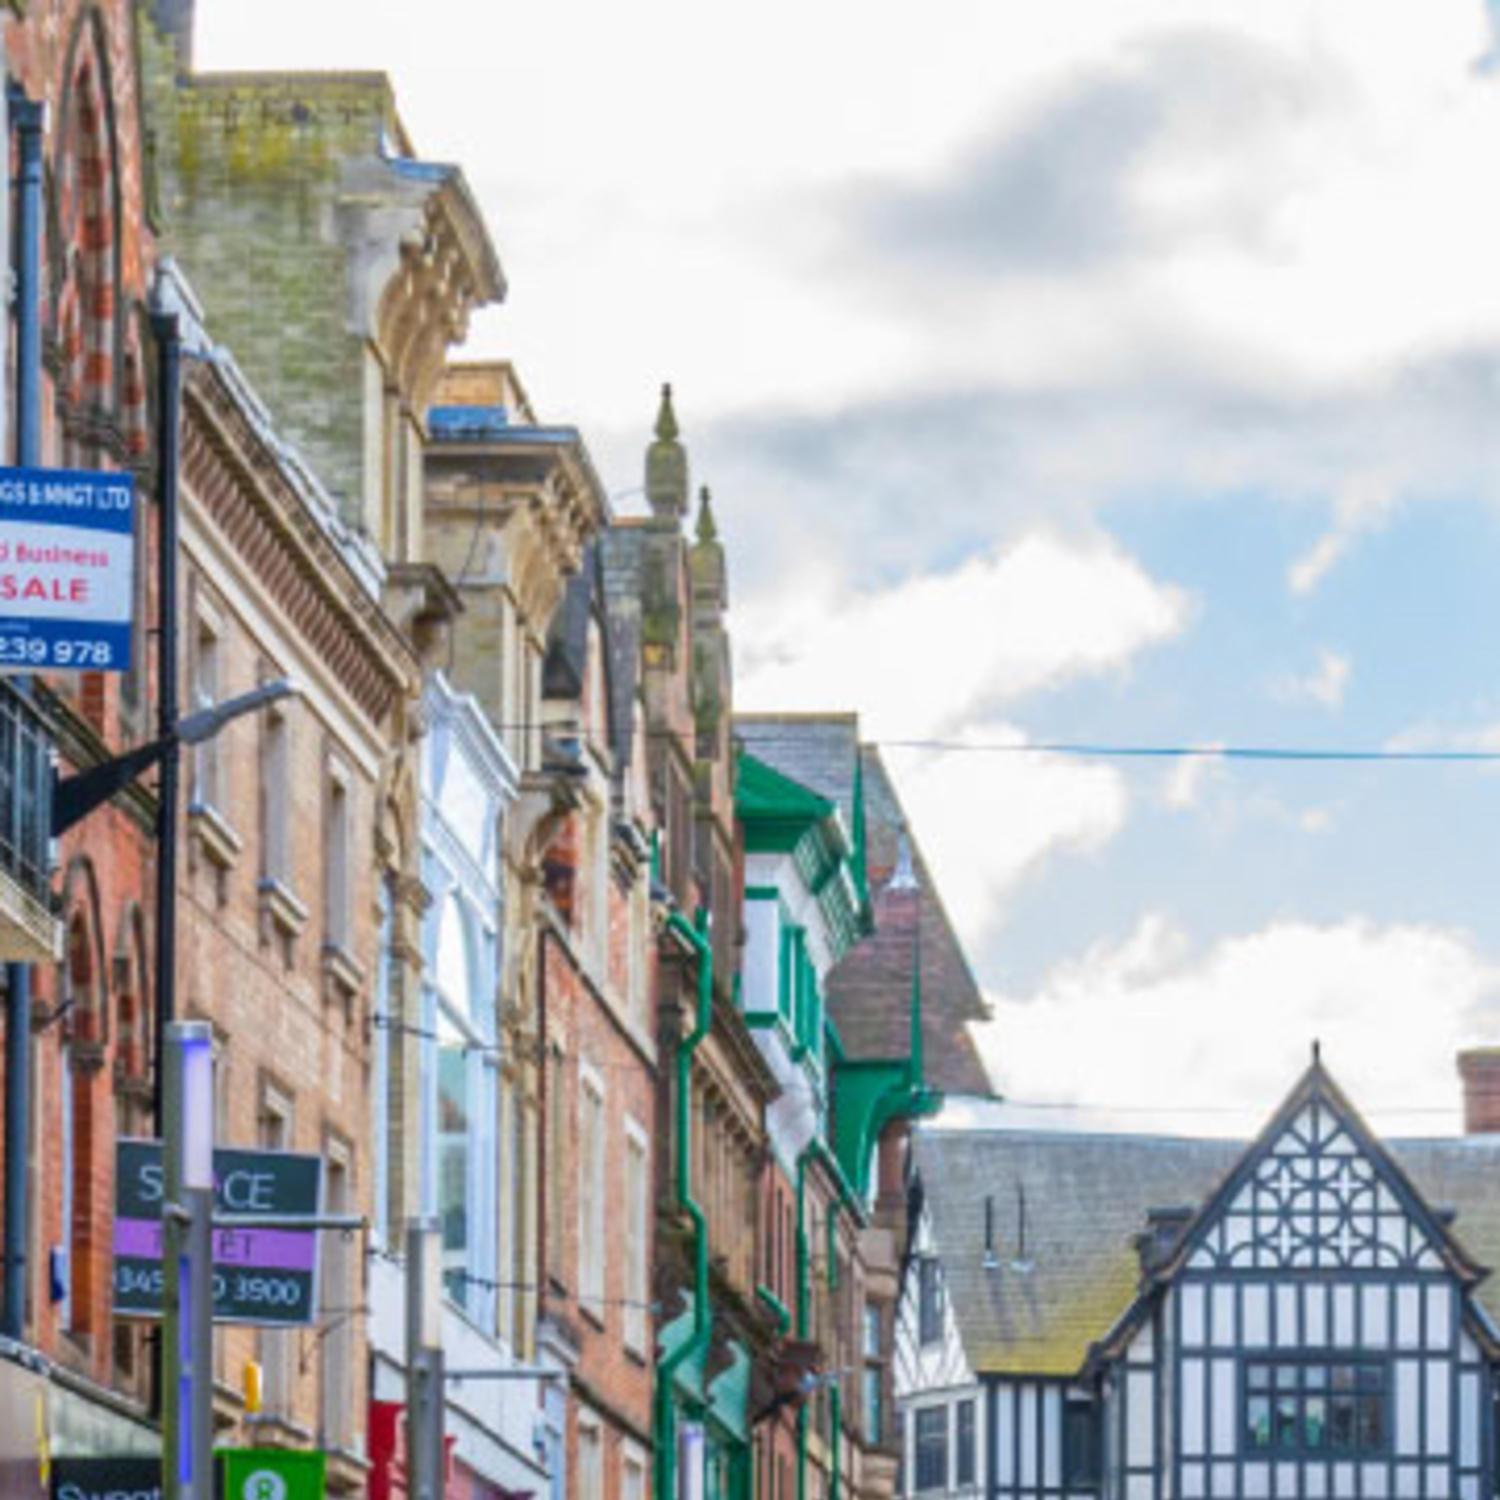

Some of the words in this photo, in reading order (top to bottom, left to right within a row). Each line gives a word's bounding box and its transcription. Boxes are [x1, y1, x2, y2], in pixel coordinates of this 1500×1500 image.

[97, 485, 131, 510] LTD
[16, 542, 109, 567] Business
[0, 573, 91, 603] SALE
[54, 640, 113, 665] 978
[137, 1164, 277, 1211] SCE
